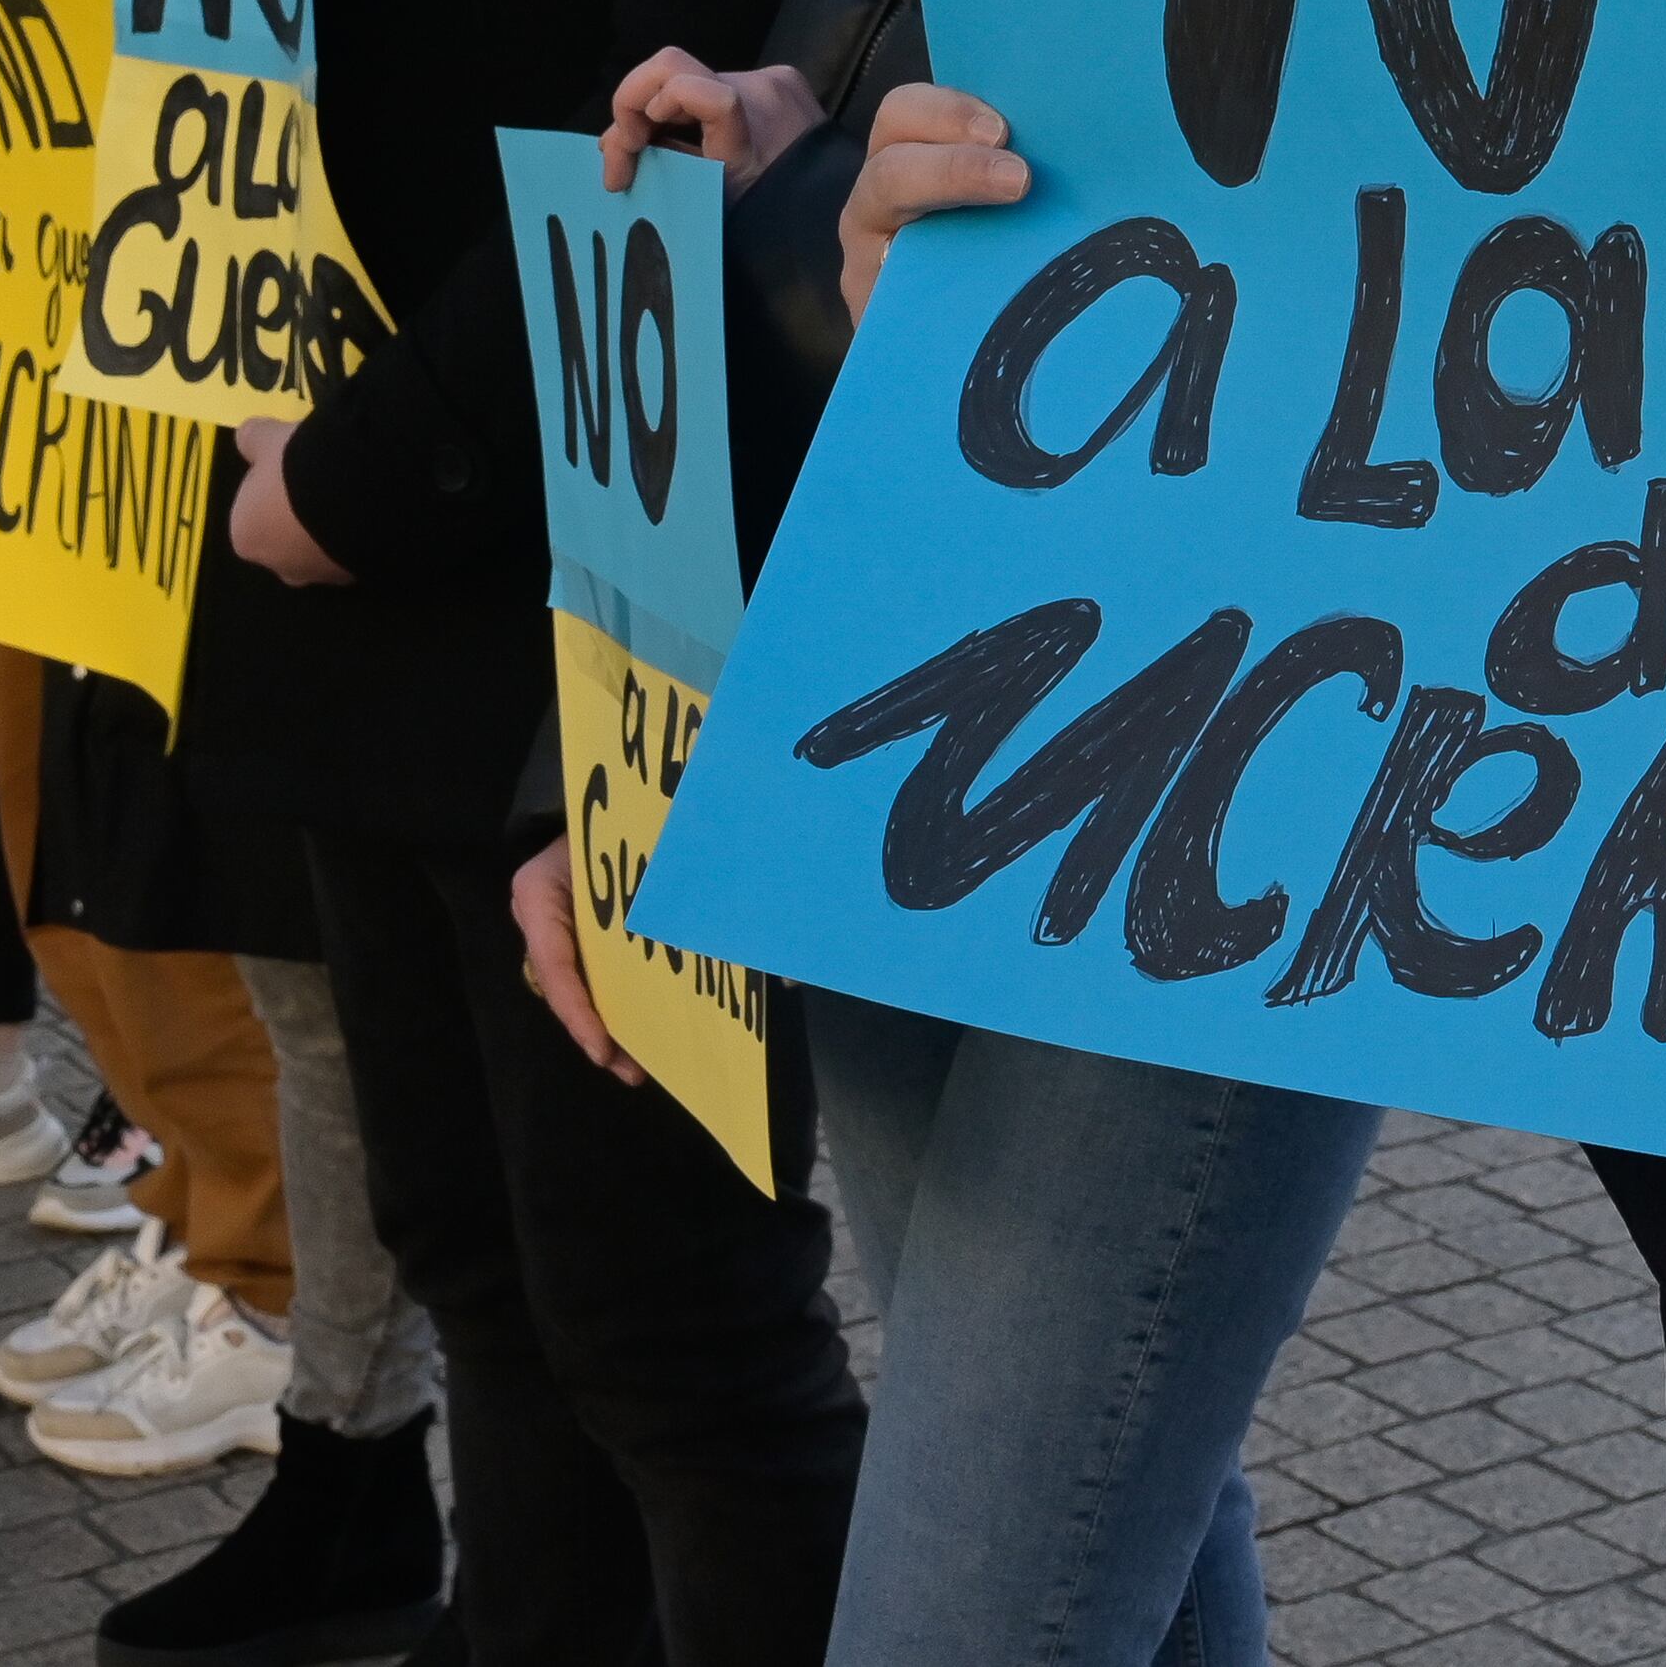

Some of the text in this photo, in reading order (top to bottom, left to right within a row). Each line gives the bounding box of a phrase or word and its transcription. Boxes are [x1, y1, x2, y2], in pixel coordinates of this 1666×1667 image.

[37, 213, 90, 348] gue
[546, 213, 678, 527] NO
[622, 668, 649, 785] a
